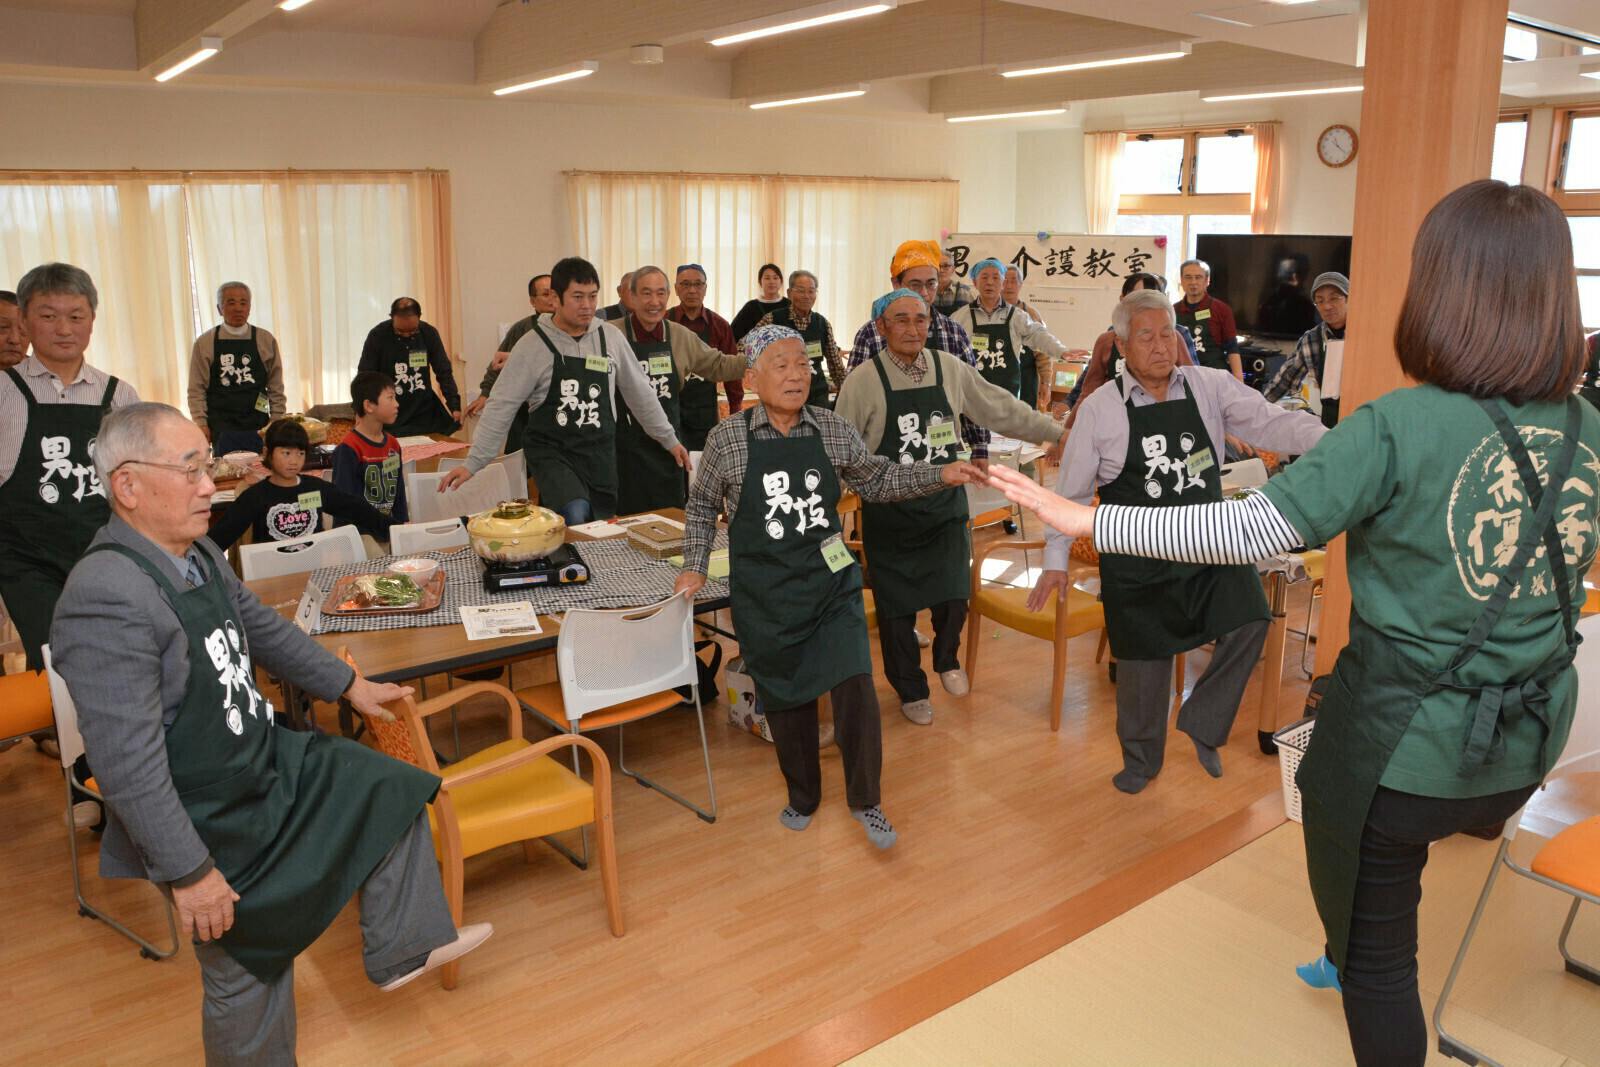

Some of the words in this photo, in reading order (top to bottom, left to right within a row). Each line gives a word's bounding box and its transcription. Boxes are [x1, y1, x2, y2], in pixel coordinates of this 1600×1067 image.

[945, 245, 1152, 280] 男介護教室
[557, 379, 601, 429] 男技
[762, 471, 830, 536] 男技
